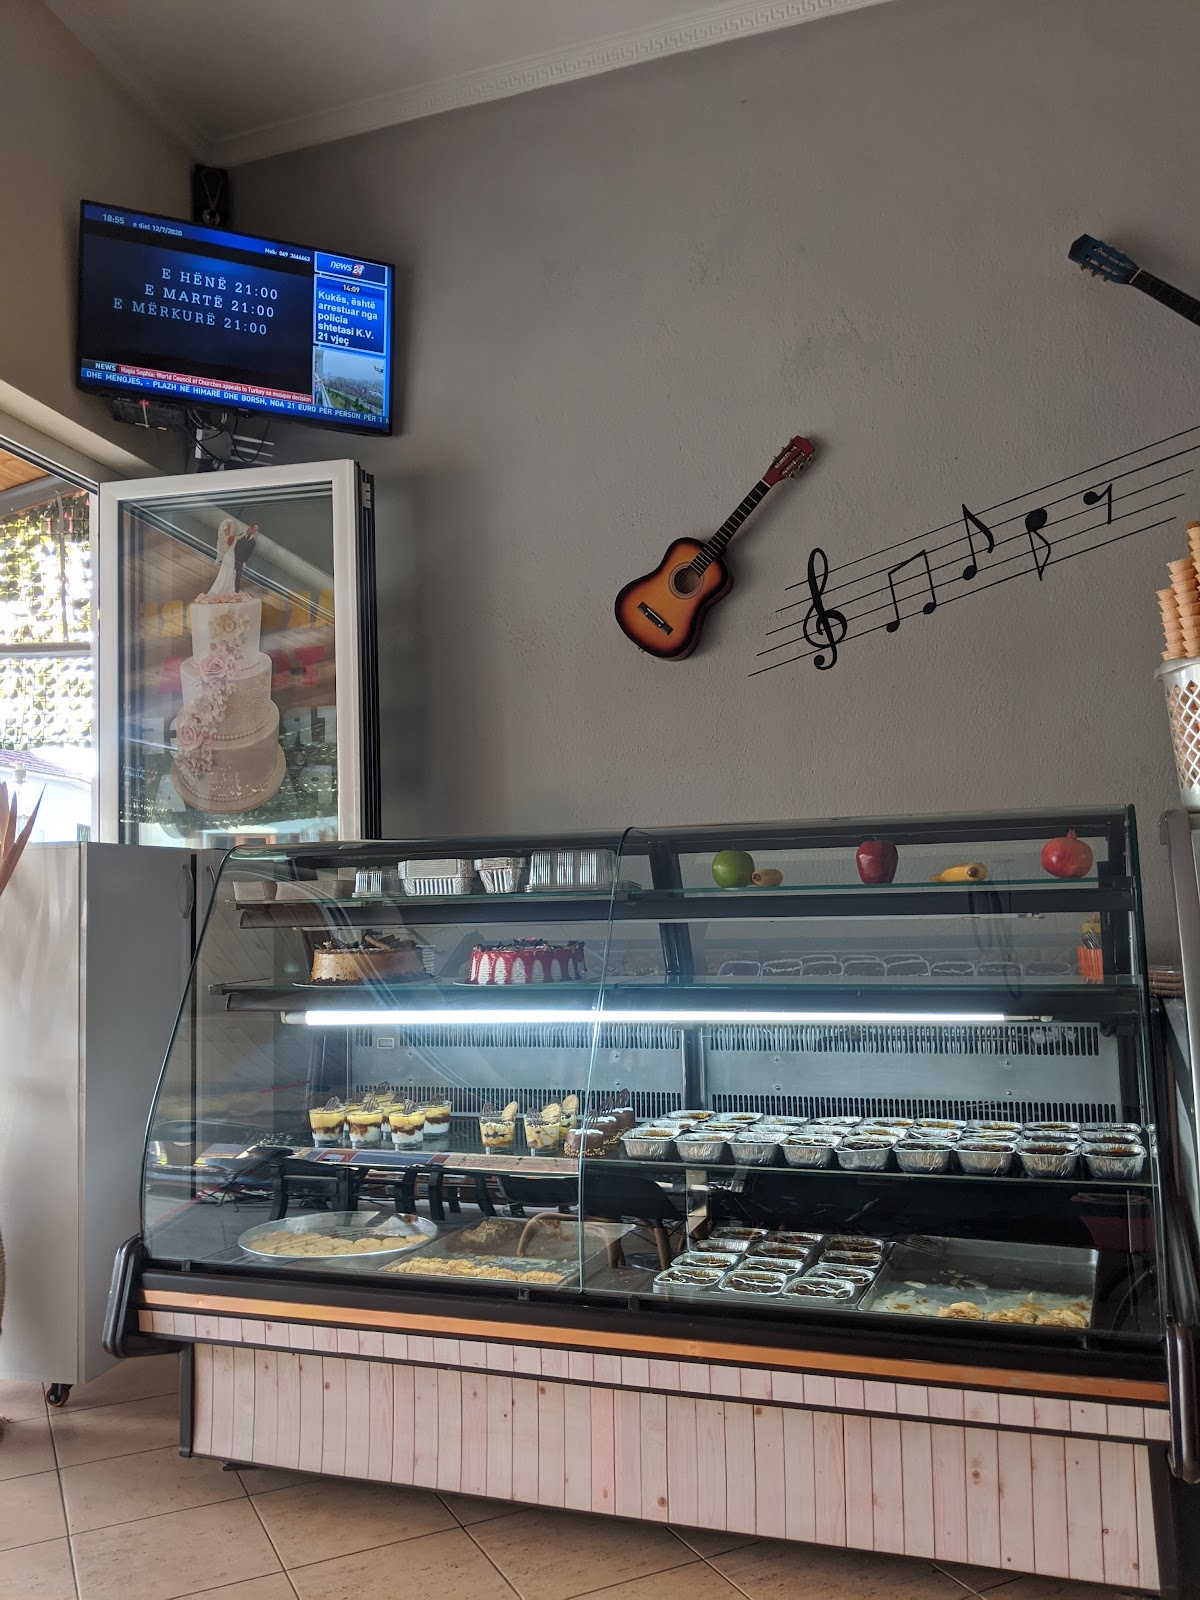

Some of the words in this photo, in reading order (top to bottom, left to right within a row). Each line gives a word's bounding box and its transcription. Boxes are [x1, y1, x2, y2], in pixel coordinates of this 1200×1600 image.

[102, 213, 125, 225] 18:55
[152, 224, 183, 237] 12/7/2020
[330, 260, 353, 272] news
[352, 264, 364, 275] 24
[161, 267, 171, 280] E
[179, 271, 228, 290] HËNË
[234, 281, 279, 300] 21:00
[342, 283, 360, 294] 14:09
[144, 283, 154, 296] E
[162, 287, 223, 309] MARTË
[230, 299, 274, 318] 21:00
[317, 290, 350, 306] Kukës,
[351, 297, 376, 310] është
[112, 297, 123, 310] E
[131, 300, 216, 326] MËRKURË
[223, 317, 267, 335] 21:00
[317, 302, 360, 317] arrestuar
[361, 310, 378, 321] nga
[317, 312, 348, 325] policia
[317, 322, 354, 336] shtetasi
[355, 328, 374, 340] K.V.
[317, 331, 329, 341] 21
[330, 334, 350, 347] vjeç
[95, 362, 117, 372] NEWS
[120, 366, 136, 375] Hagia
[136, 369, 156, 378] Sophia:
[156, 372, 172, 380] World
[172, 374, 192, 384] Council
[198, 378, 222, 389] Churches
[222, 382, 241, 393] appeals
[247, 386, 265, 396] Turkey
[272, 391, 292, 400] mosque
[292, 393, 312, 403] decision
[86, 370, 103, 380] DHE
[105, 373, 143, 387] MËNGJES,
[152, 381, 177, 391] PLAZH
[179, 384, 190, 393] NË
[193, 386, 221, 398] HIMARË
[241, 395, 267, 406] BORSH,
[269, 399, 285, 408] NGA
[286, 402, 295, 410] 21
[298, 404, 317, 413] EURO
[334, 409, 361, 420] PERSON
